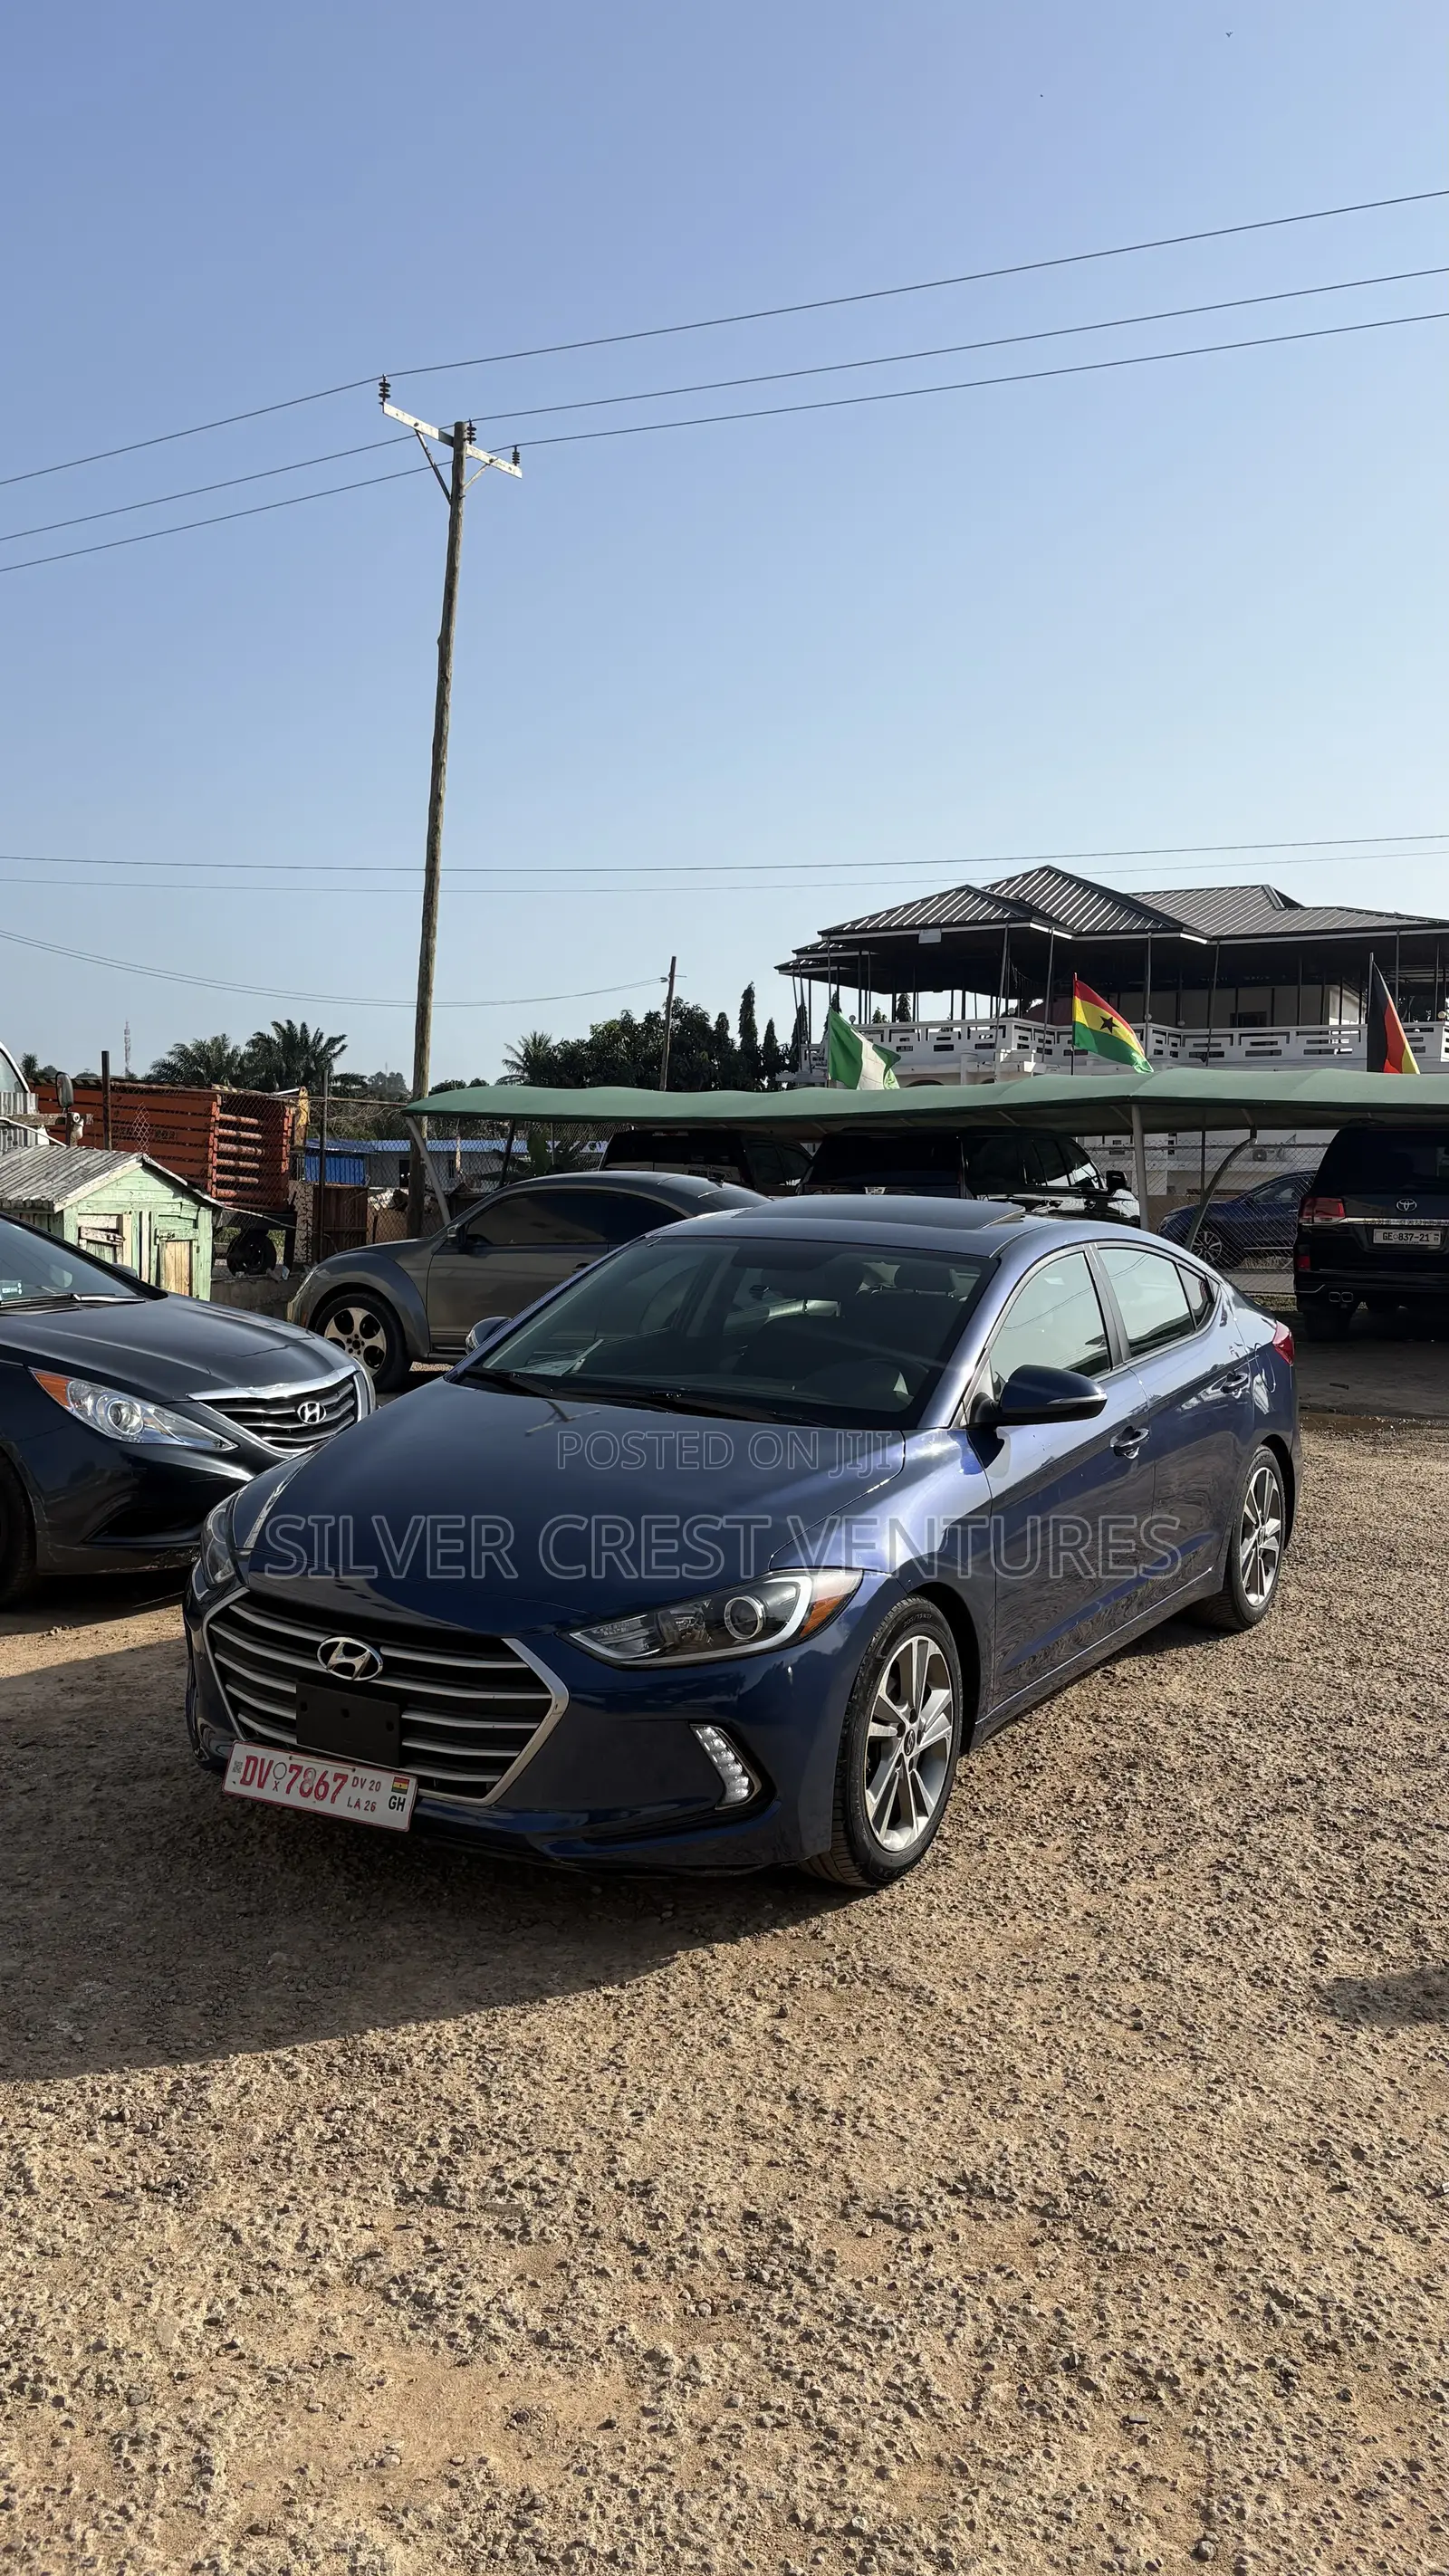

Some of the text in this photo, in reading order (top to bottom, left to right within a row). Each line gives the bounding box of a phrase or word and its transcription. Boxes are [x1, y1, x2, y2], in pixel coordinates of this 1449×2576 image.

[1382, 1231, 1394, 1241] GE
[1398, 1232, 1430, 1242] 837-21
[239, 1755, 350, 1805] DV 7867
[350, 1776, 382, 1793] DV 20
[346, 1796, 378, 1813] LA 26
[388, 1795, 407, 1813] GH
